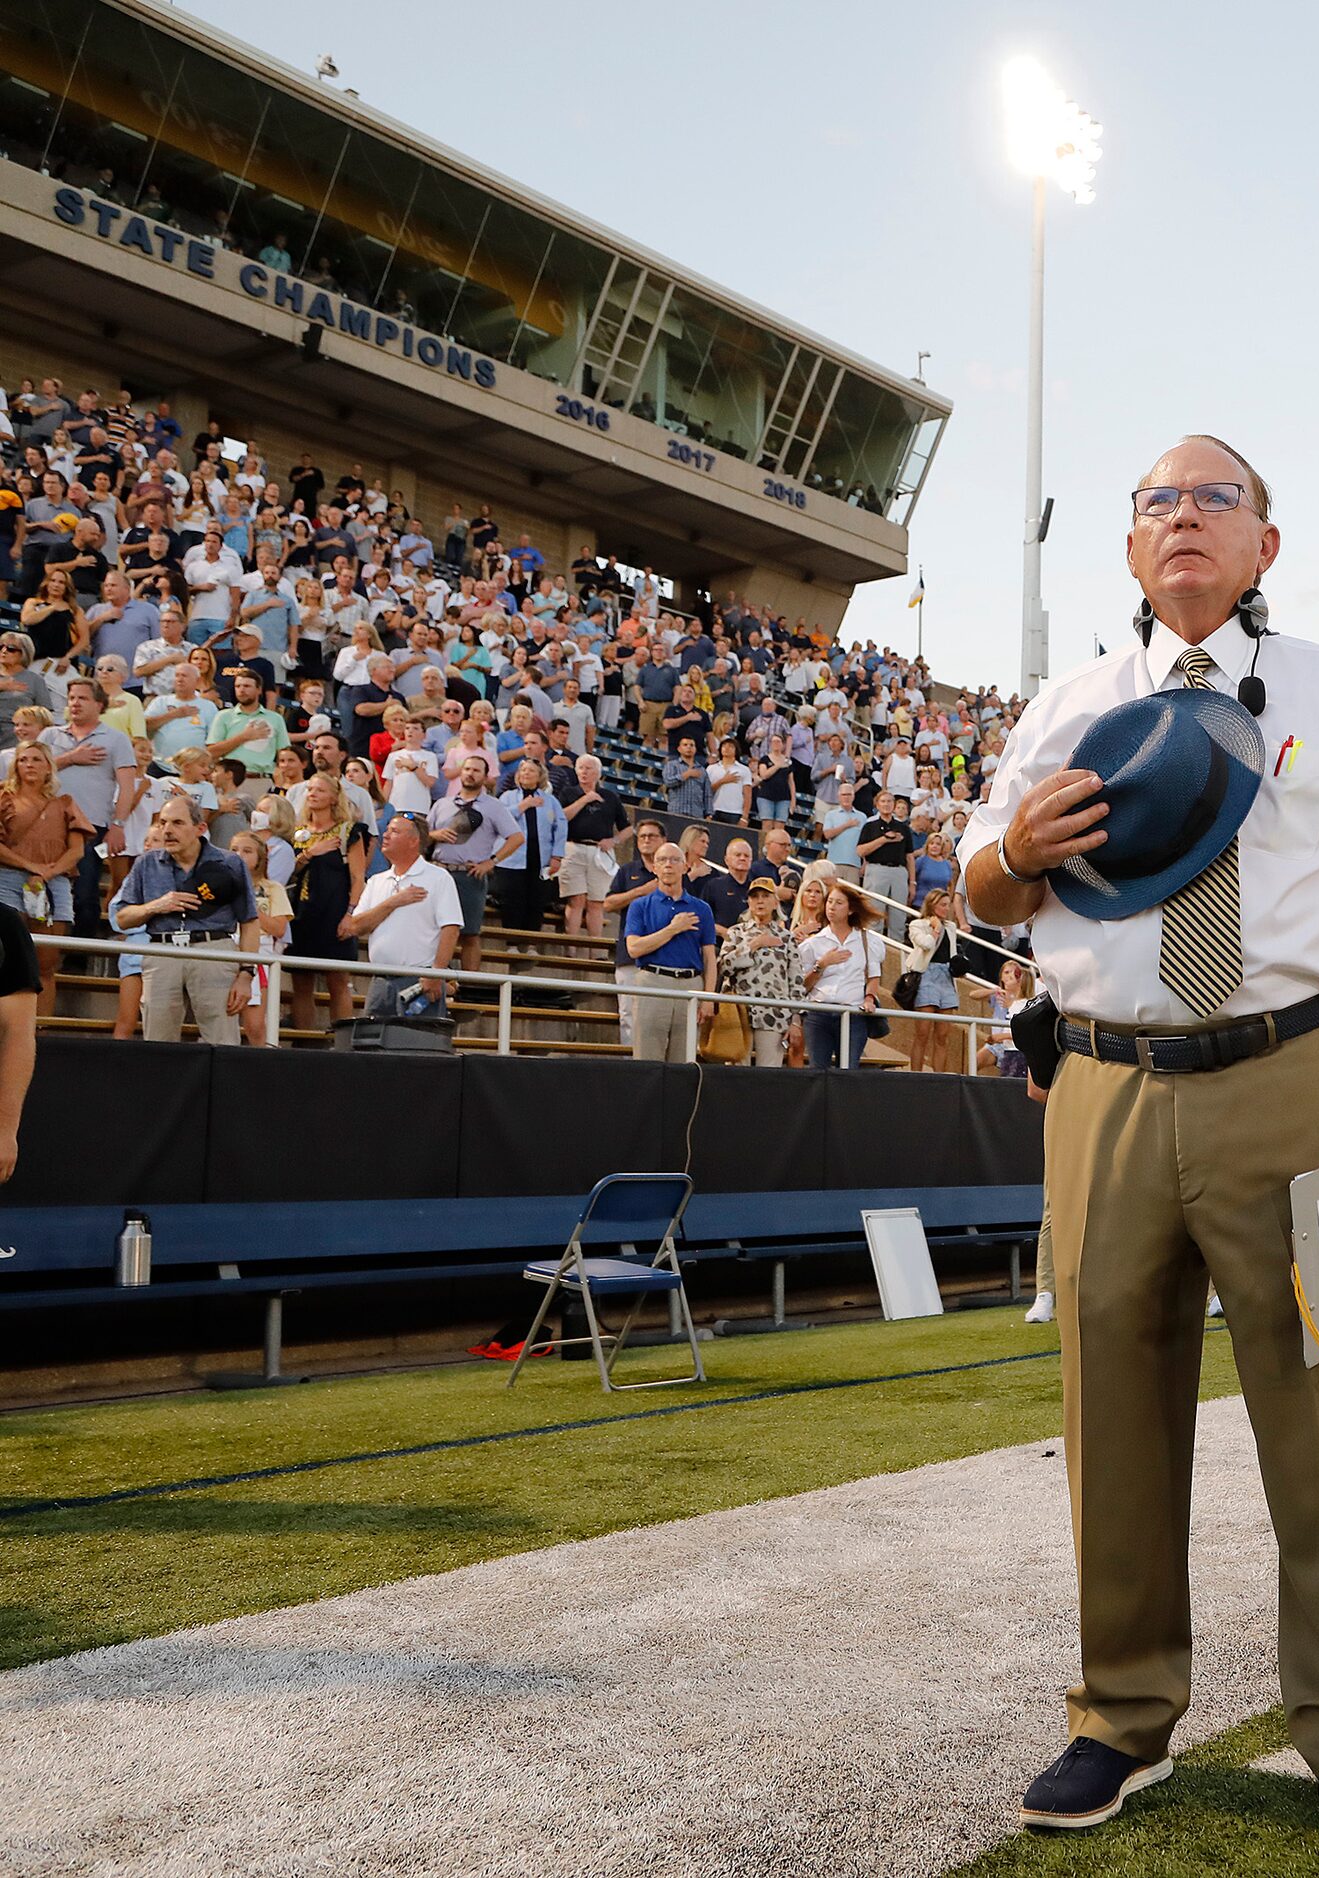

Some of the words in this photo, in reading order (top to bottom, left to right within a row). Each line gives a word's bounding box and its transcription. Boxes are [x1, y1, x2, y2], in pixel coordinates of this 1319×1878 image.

[54, 188, 216, 278] STATE
[240, 263, 496, 388] CHAMPIONS
[555, 395, 610, 431] 2016
[667, 440, 715, 472] 2017
[763, 478, 806, 509] 2018
